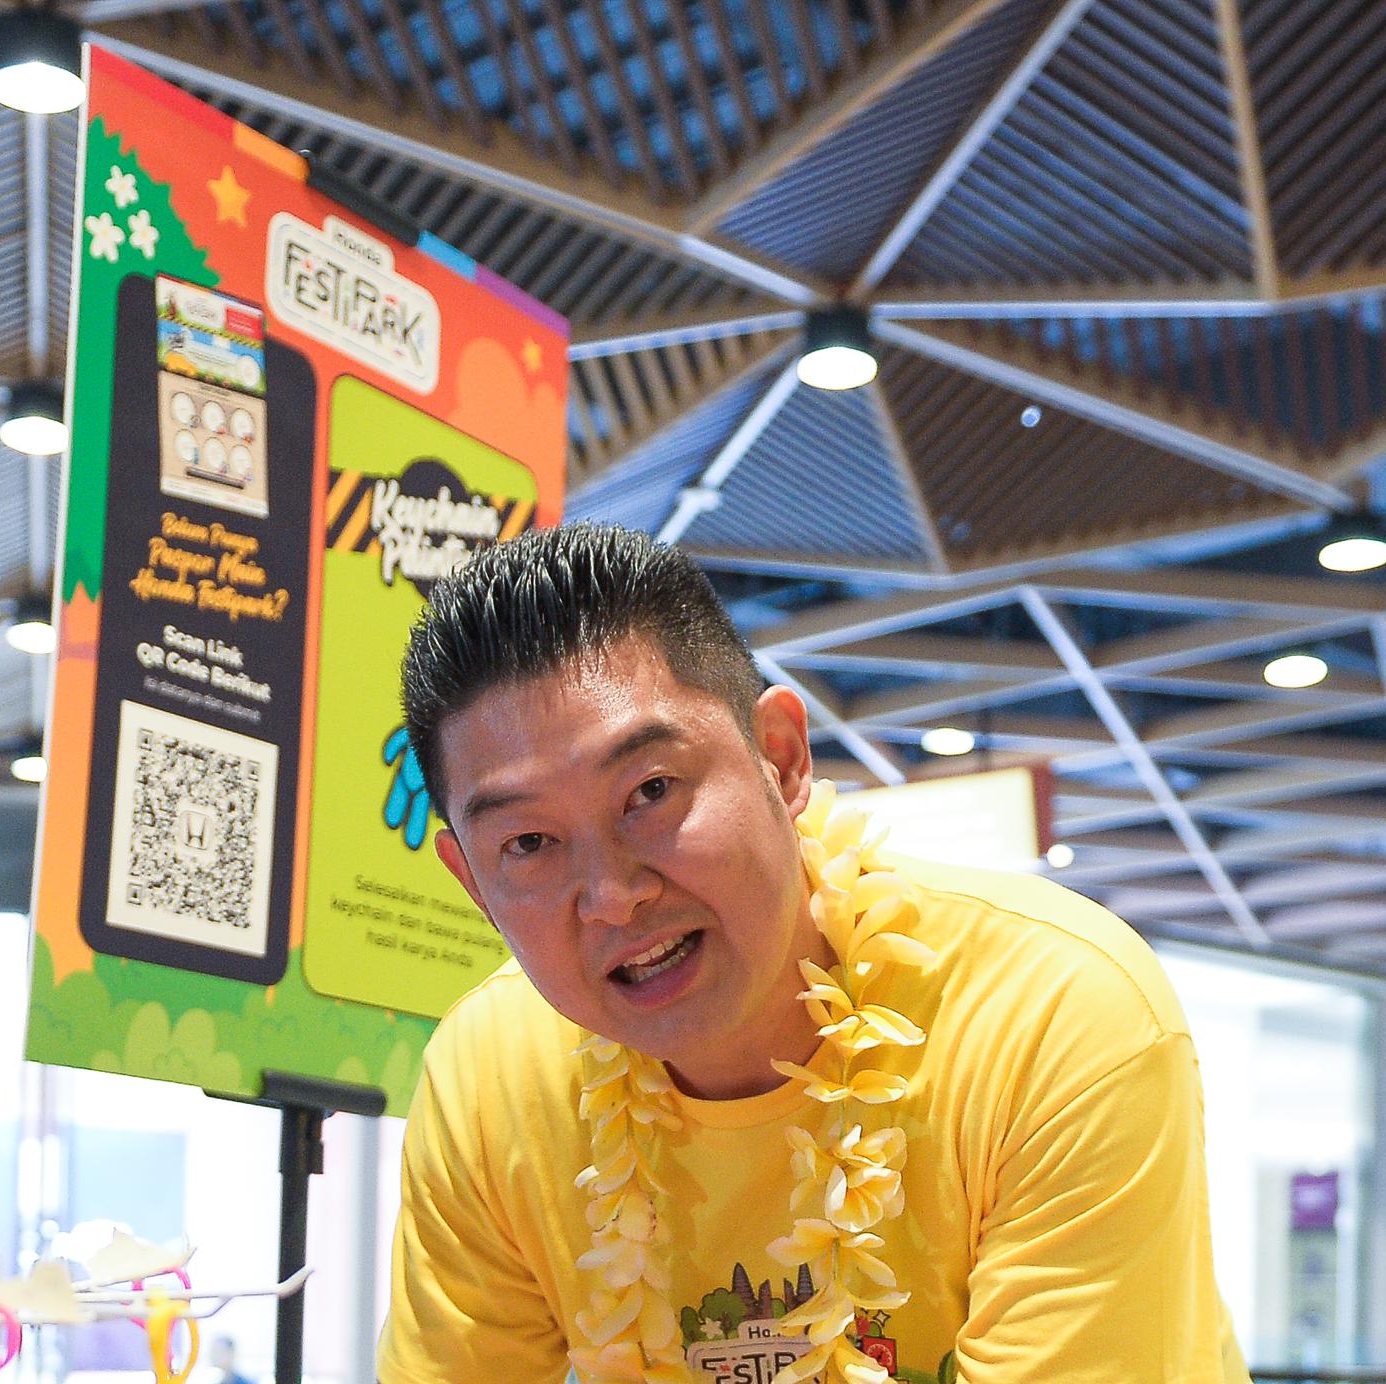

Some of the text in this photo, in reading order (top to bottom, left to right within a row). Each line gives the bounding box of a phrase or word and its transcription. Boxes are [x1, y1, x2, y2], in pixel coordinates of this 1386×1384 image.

[371, 479, 502, 546] Keychain
[136, 642, 272, 704] QR Code Berikut
[163, 624, 244, 669] Scan Link
